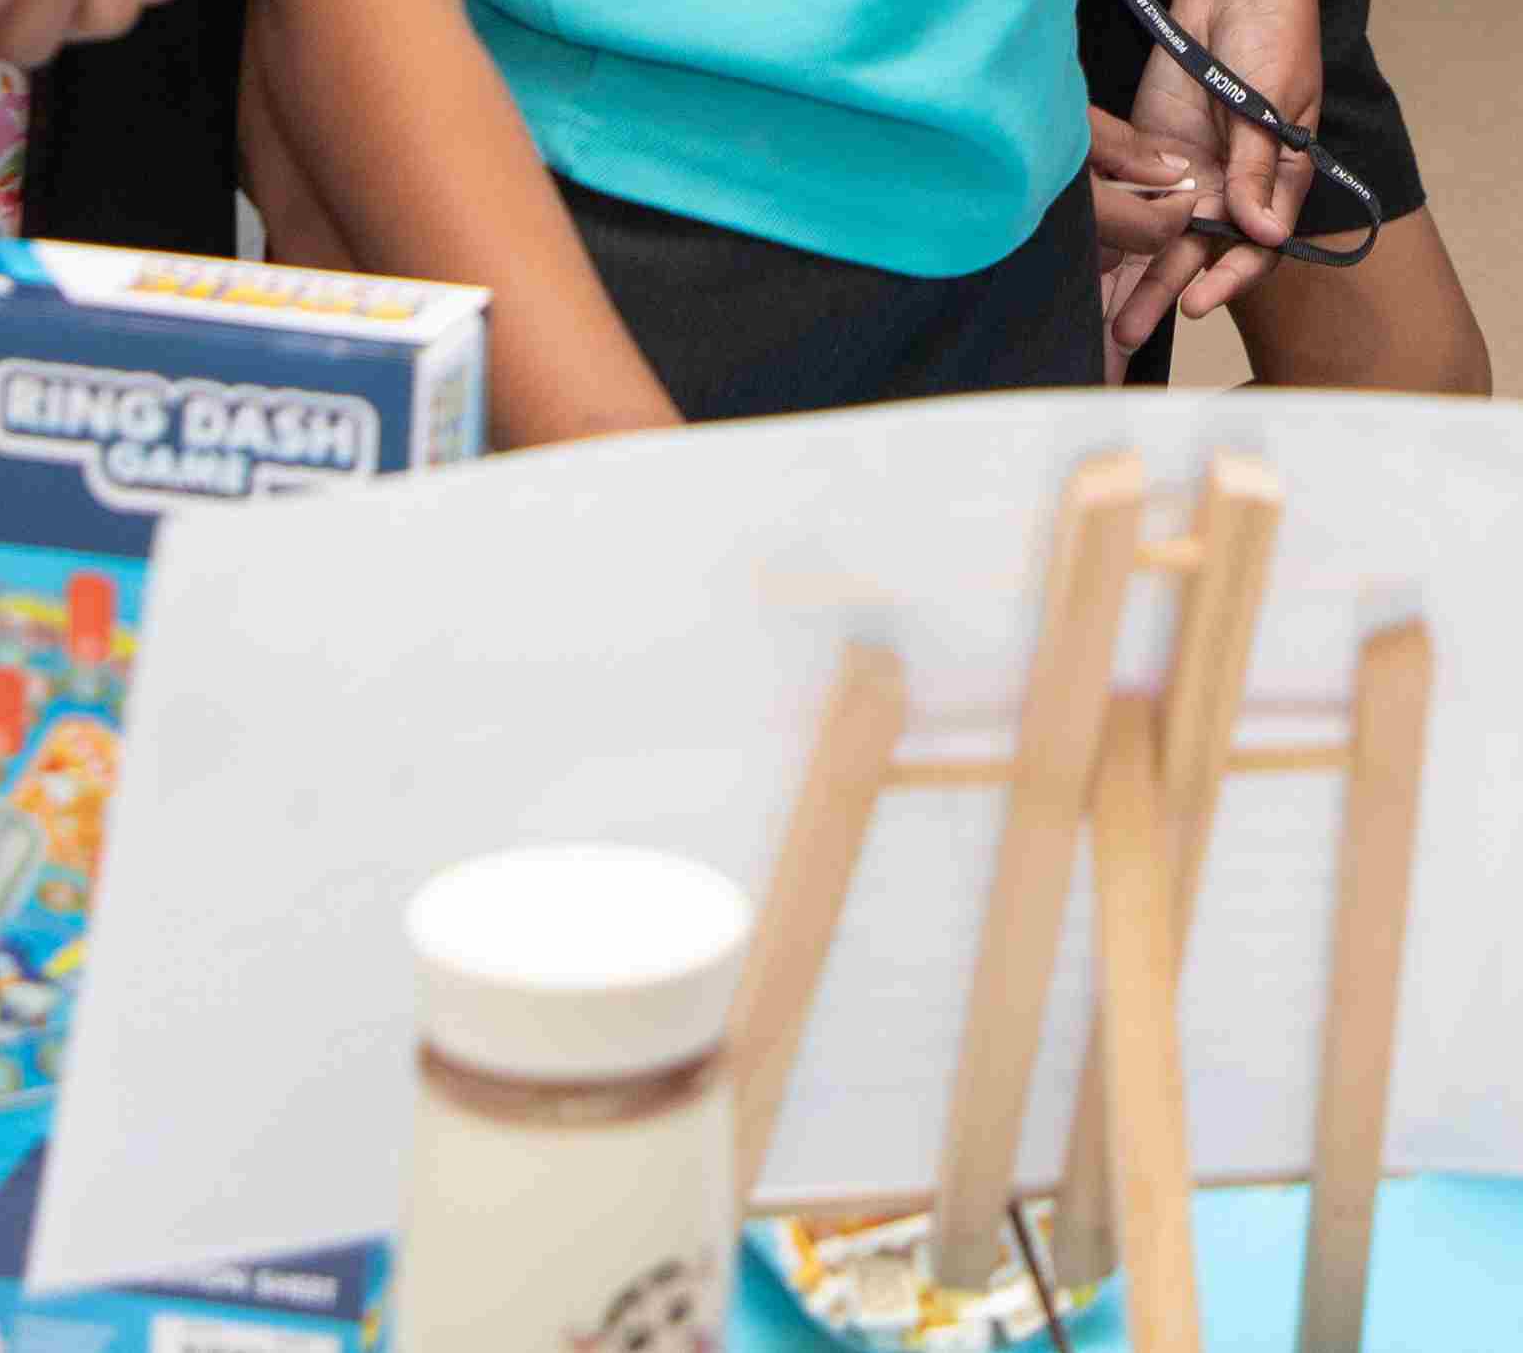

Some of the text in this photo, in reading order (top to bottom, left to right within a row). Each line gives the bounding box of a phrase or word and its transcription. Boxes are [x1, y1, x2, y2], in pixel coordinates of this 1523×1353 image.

[6, 371, 357, 468] RING DASH
[105, 440, 252, 497] GAME
